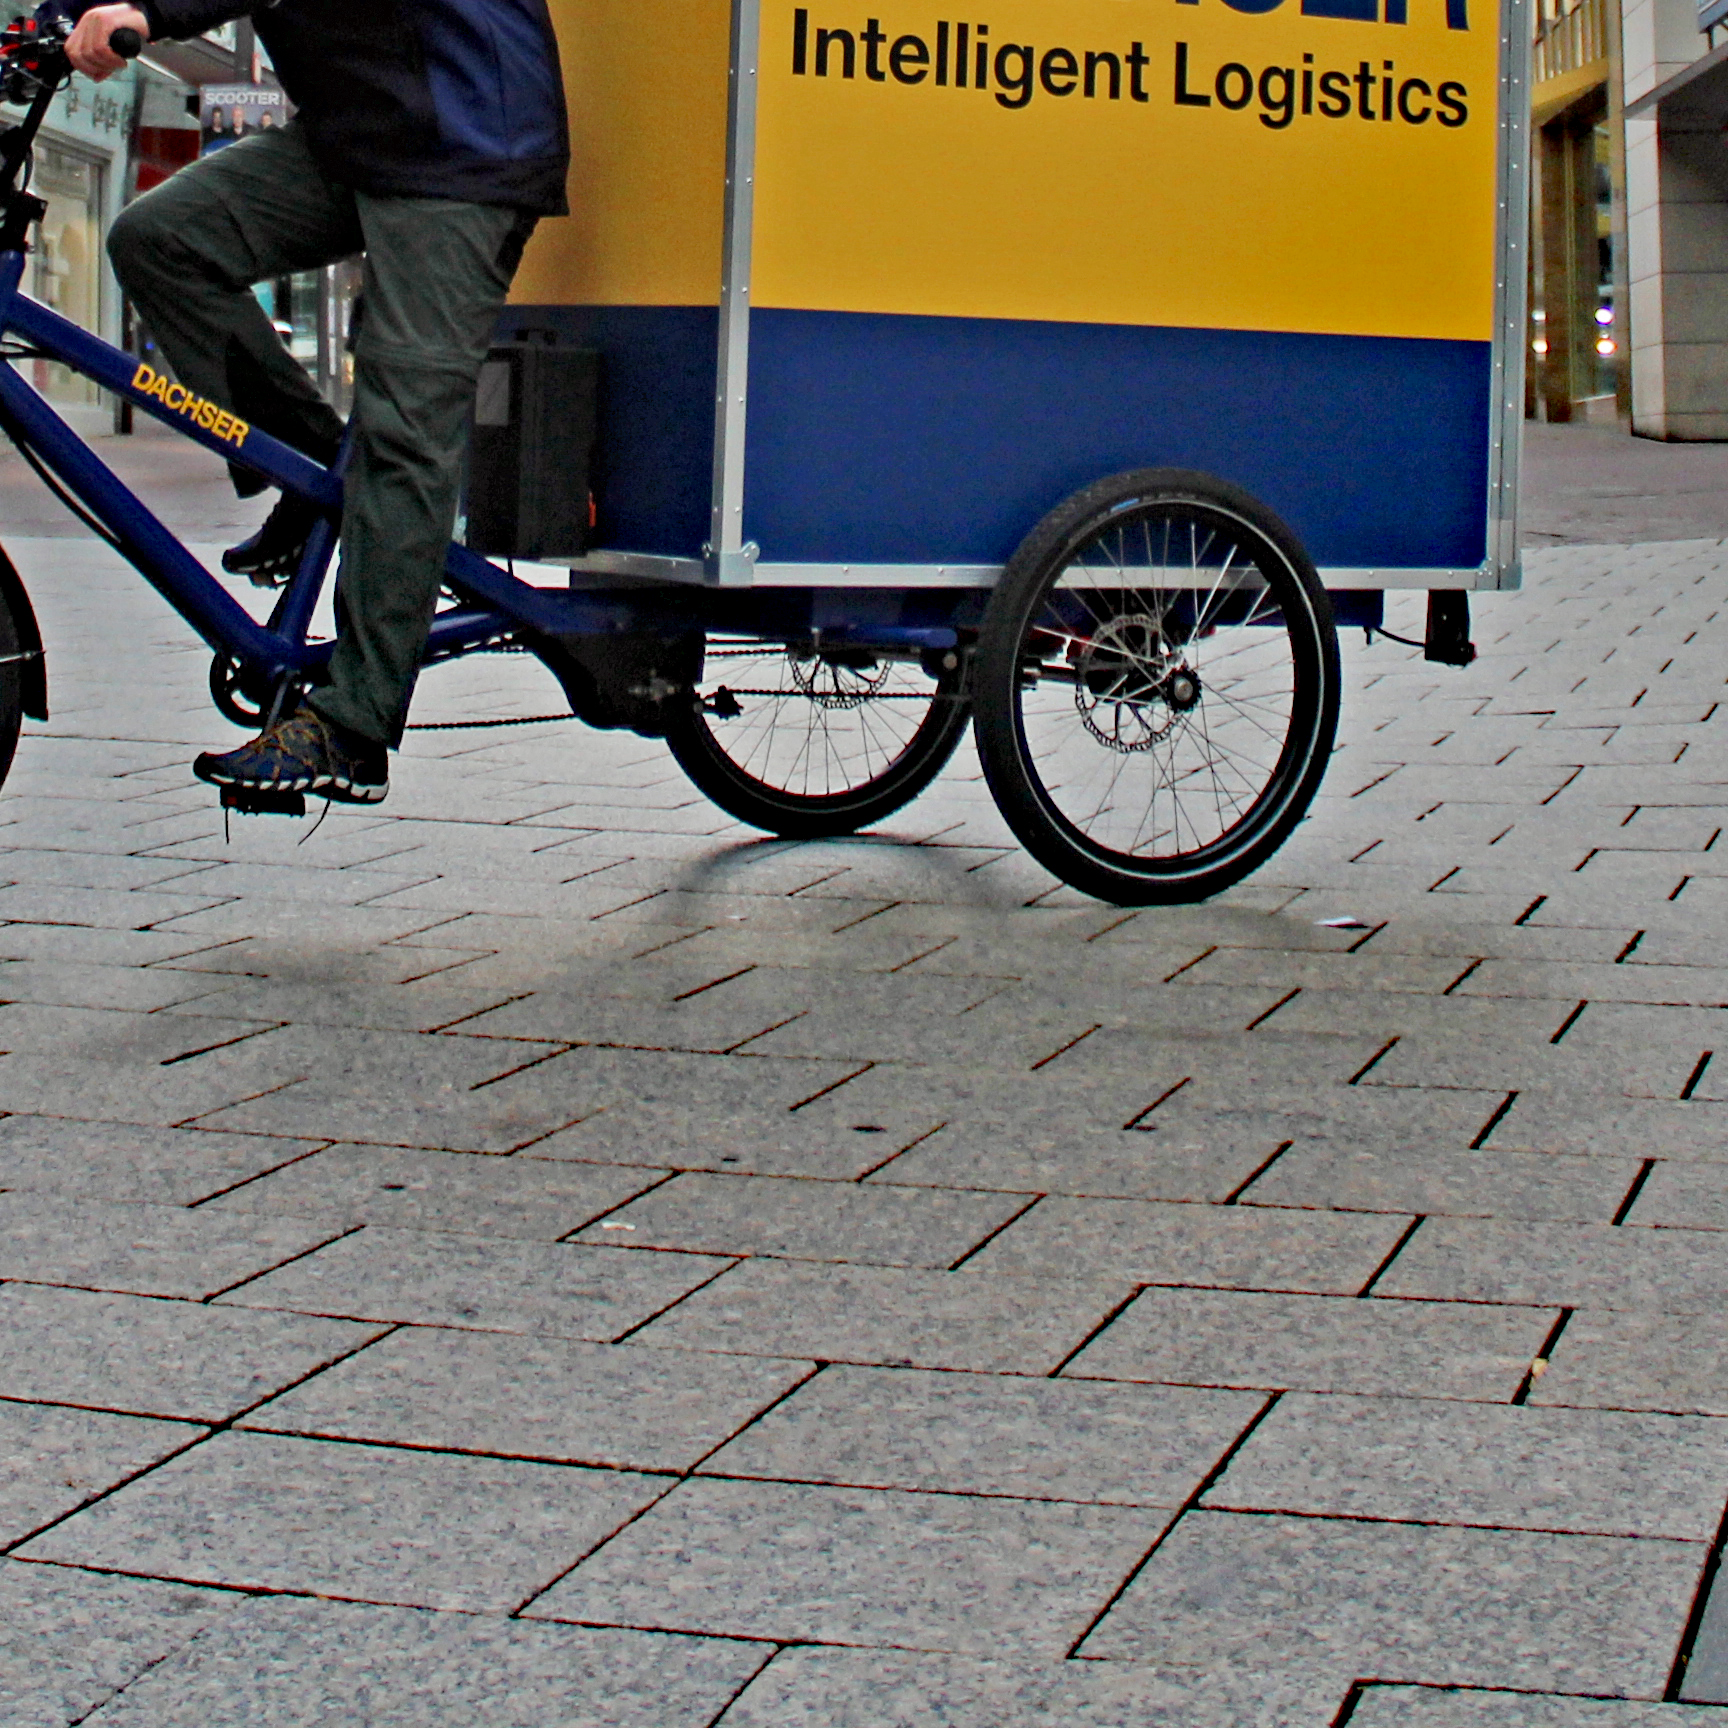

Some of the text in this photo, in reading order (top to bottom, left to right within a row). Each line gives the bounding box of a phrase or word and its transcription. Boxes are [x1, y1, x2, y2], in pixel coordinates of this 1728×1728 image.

[205, 91, 280, 106] SCOOTER
[791, 7, 1470, 131] Intelligent Logistics
[131, 363, 250, 448] DACHSER
